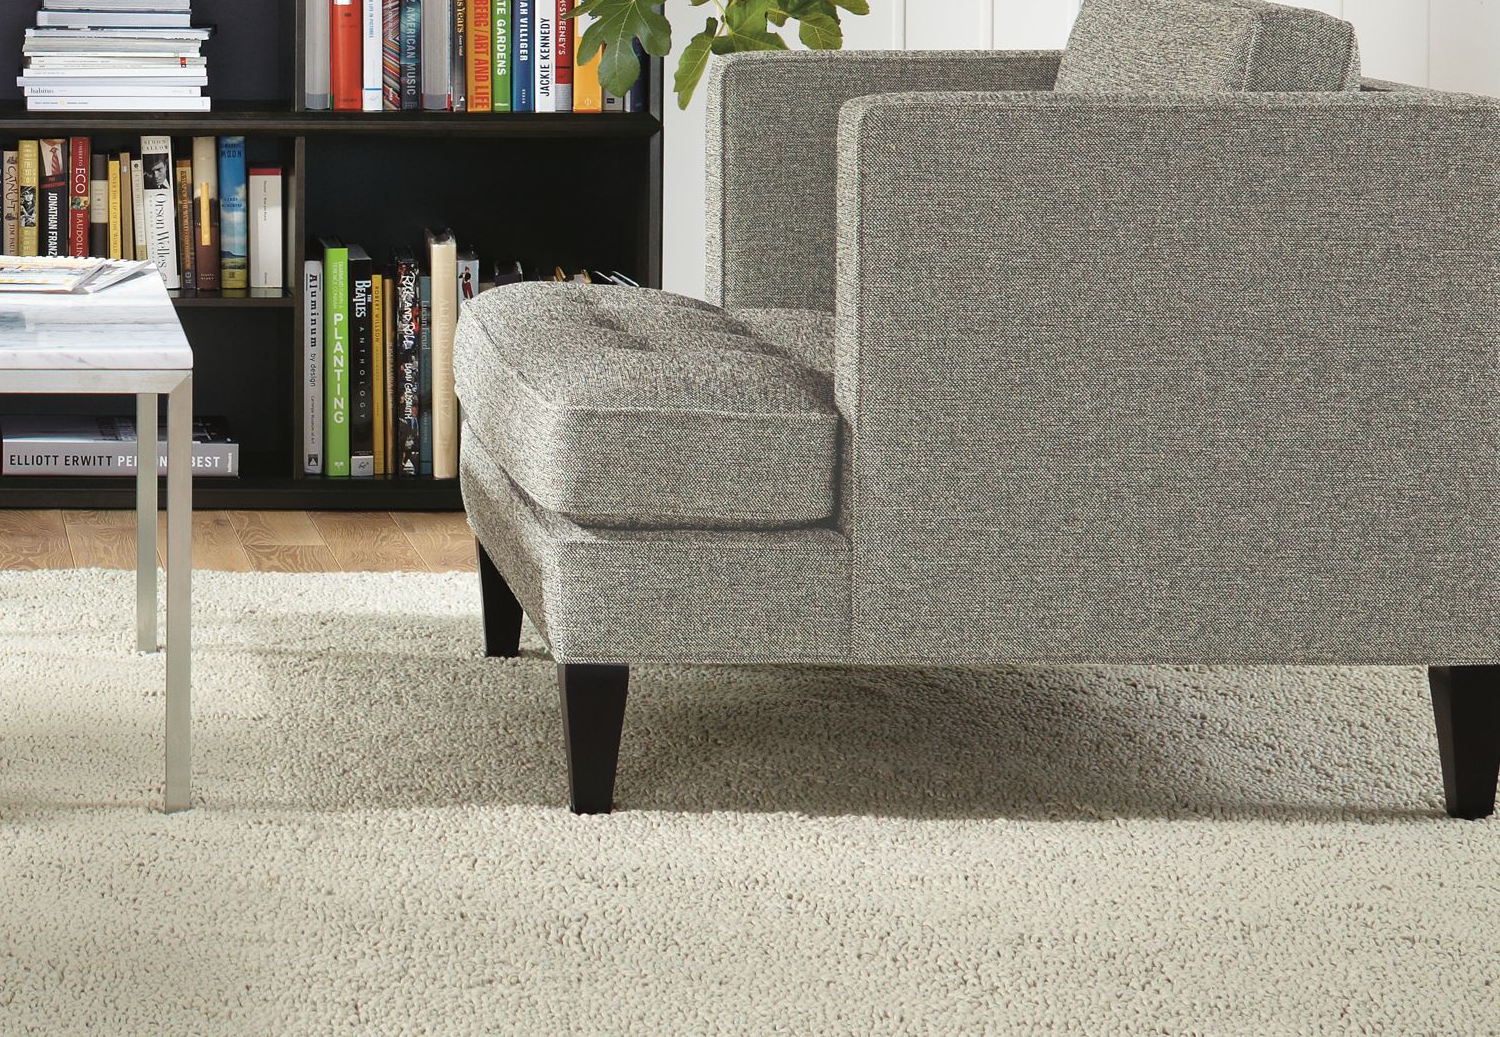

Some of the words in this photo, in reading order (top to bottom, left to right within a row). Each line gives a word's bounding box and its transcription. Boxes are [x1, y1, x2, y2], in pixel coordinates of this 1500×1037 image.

[406, 6, 416, 59] AMERICAN
[456, 6, 465, 33] Years
[497, 19, 506, 76] GARDENS
[519, 17, 528, 62] VILLIGER
[540, 17, 550, 61] KENNEDY
[406, 62, 416, 96] MUSIC
[474, 57, 489, 82] AND
[540, 64, 550, 97] JACKIE
[474, 85, 489, 109] LIFE
[48, 192, 57, 230] JONATHAN
[154, 193, 167, 229] Orson
[48, 231, 58, 256] FRANZ
[156, 231, 170, 268] Welles
[352, 280, 371, 318] BEATLES
[401, 273, 415, 302] ROCK
[309, 273, 318, 348] Aluminum
[402, 302, 412, 321] AND
[421, 300, 429, 327] Lucian
[402, 323, 415, 349] ROLL
[421, 327, 430, 350] Freud
[310, 353, 317, 362] by
[333, 312, 345, 424] PLANTING
[309, 363, 318, 387] design
[9, 454, 59, 466] ELLIOTT
[64, 455, 113, 467] ERWITT
